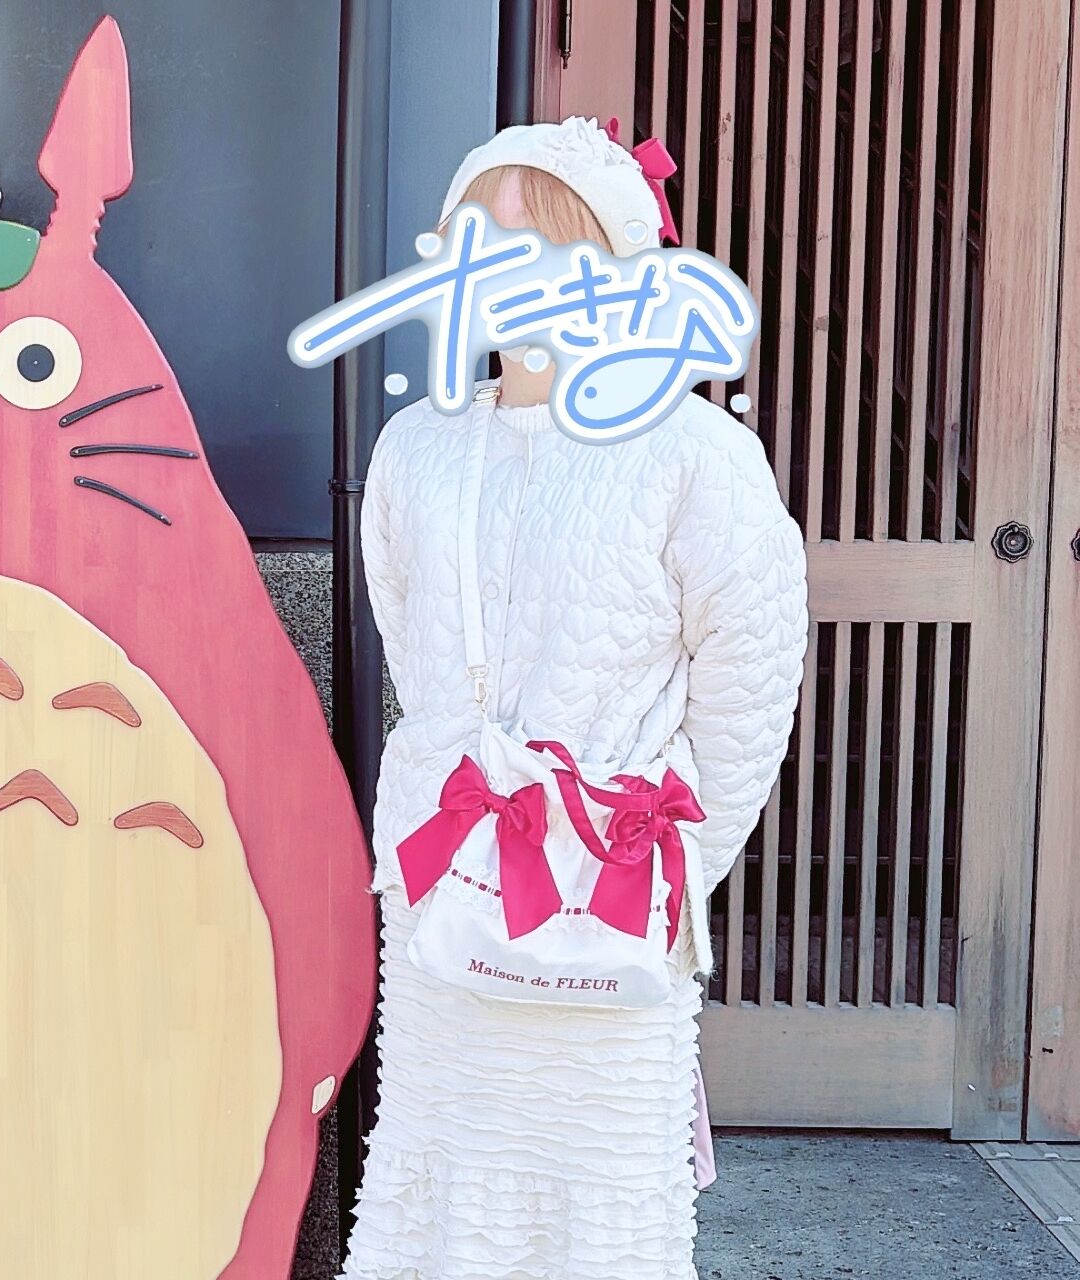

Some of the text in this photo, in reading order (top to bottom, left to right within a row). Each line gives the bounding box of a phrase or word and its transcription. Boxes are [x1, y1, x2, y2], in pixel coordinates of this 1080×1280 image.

[466, 958, 619, 993] Maison de FLEUR
